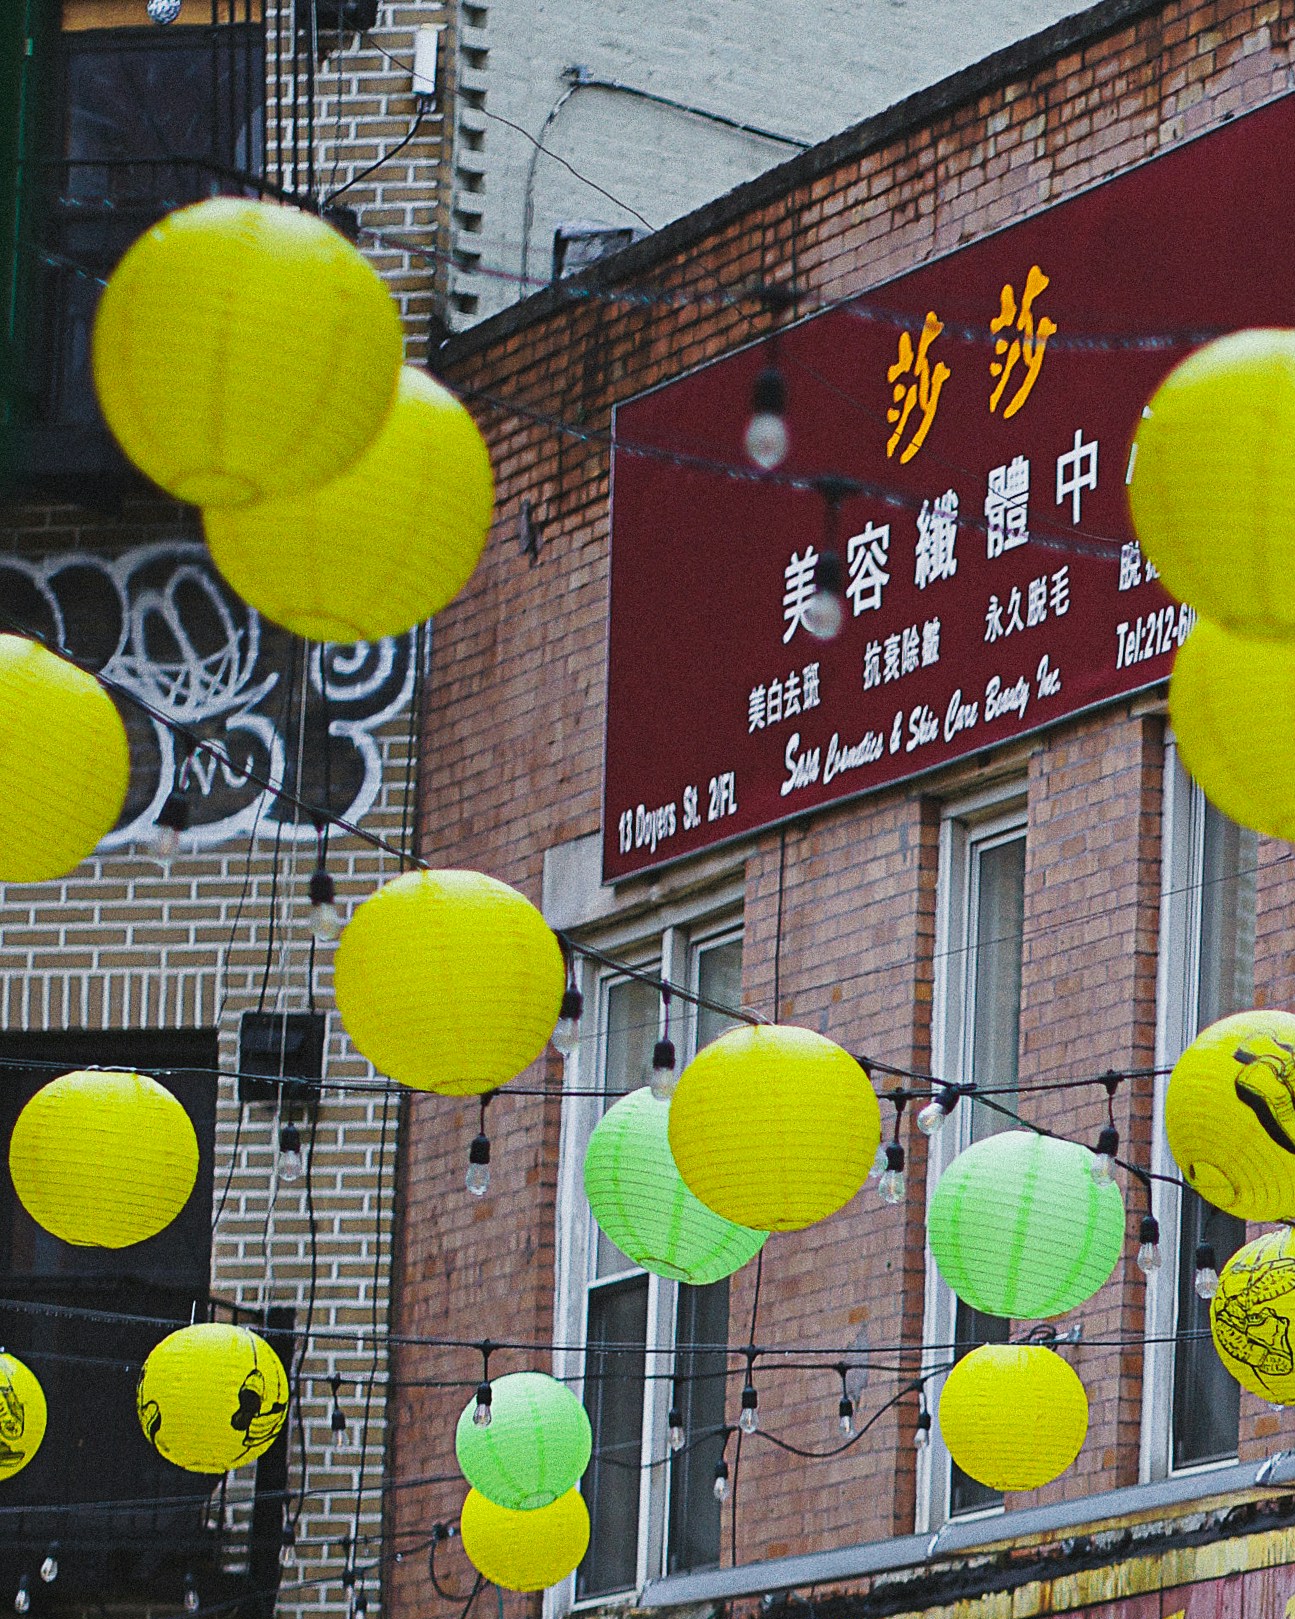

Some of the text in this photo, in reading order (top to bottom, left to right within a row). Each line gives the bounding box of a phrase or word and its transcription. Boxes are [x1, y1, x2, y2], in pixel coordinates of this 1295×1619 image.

[782, 405, 1138, 643] 美容纖體中
[780, 732, 820, 796] Sasa
[906, 704, 939, 752] Skin
[944, 689, 978, 742] Care
[984, 675, 1030, 721] Beauty
[635, 802, 676, 854] Doyers
